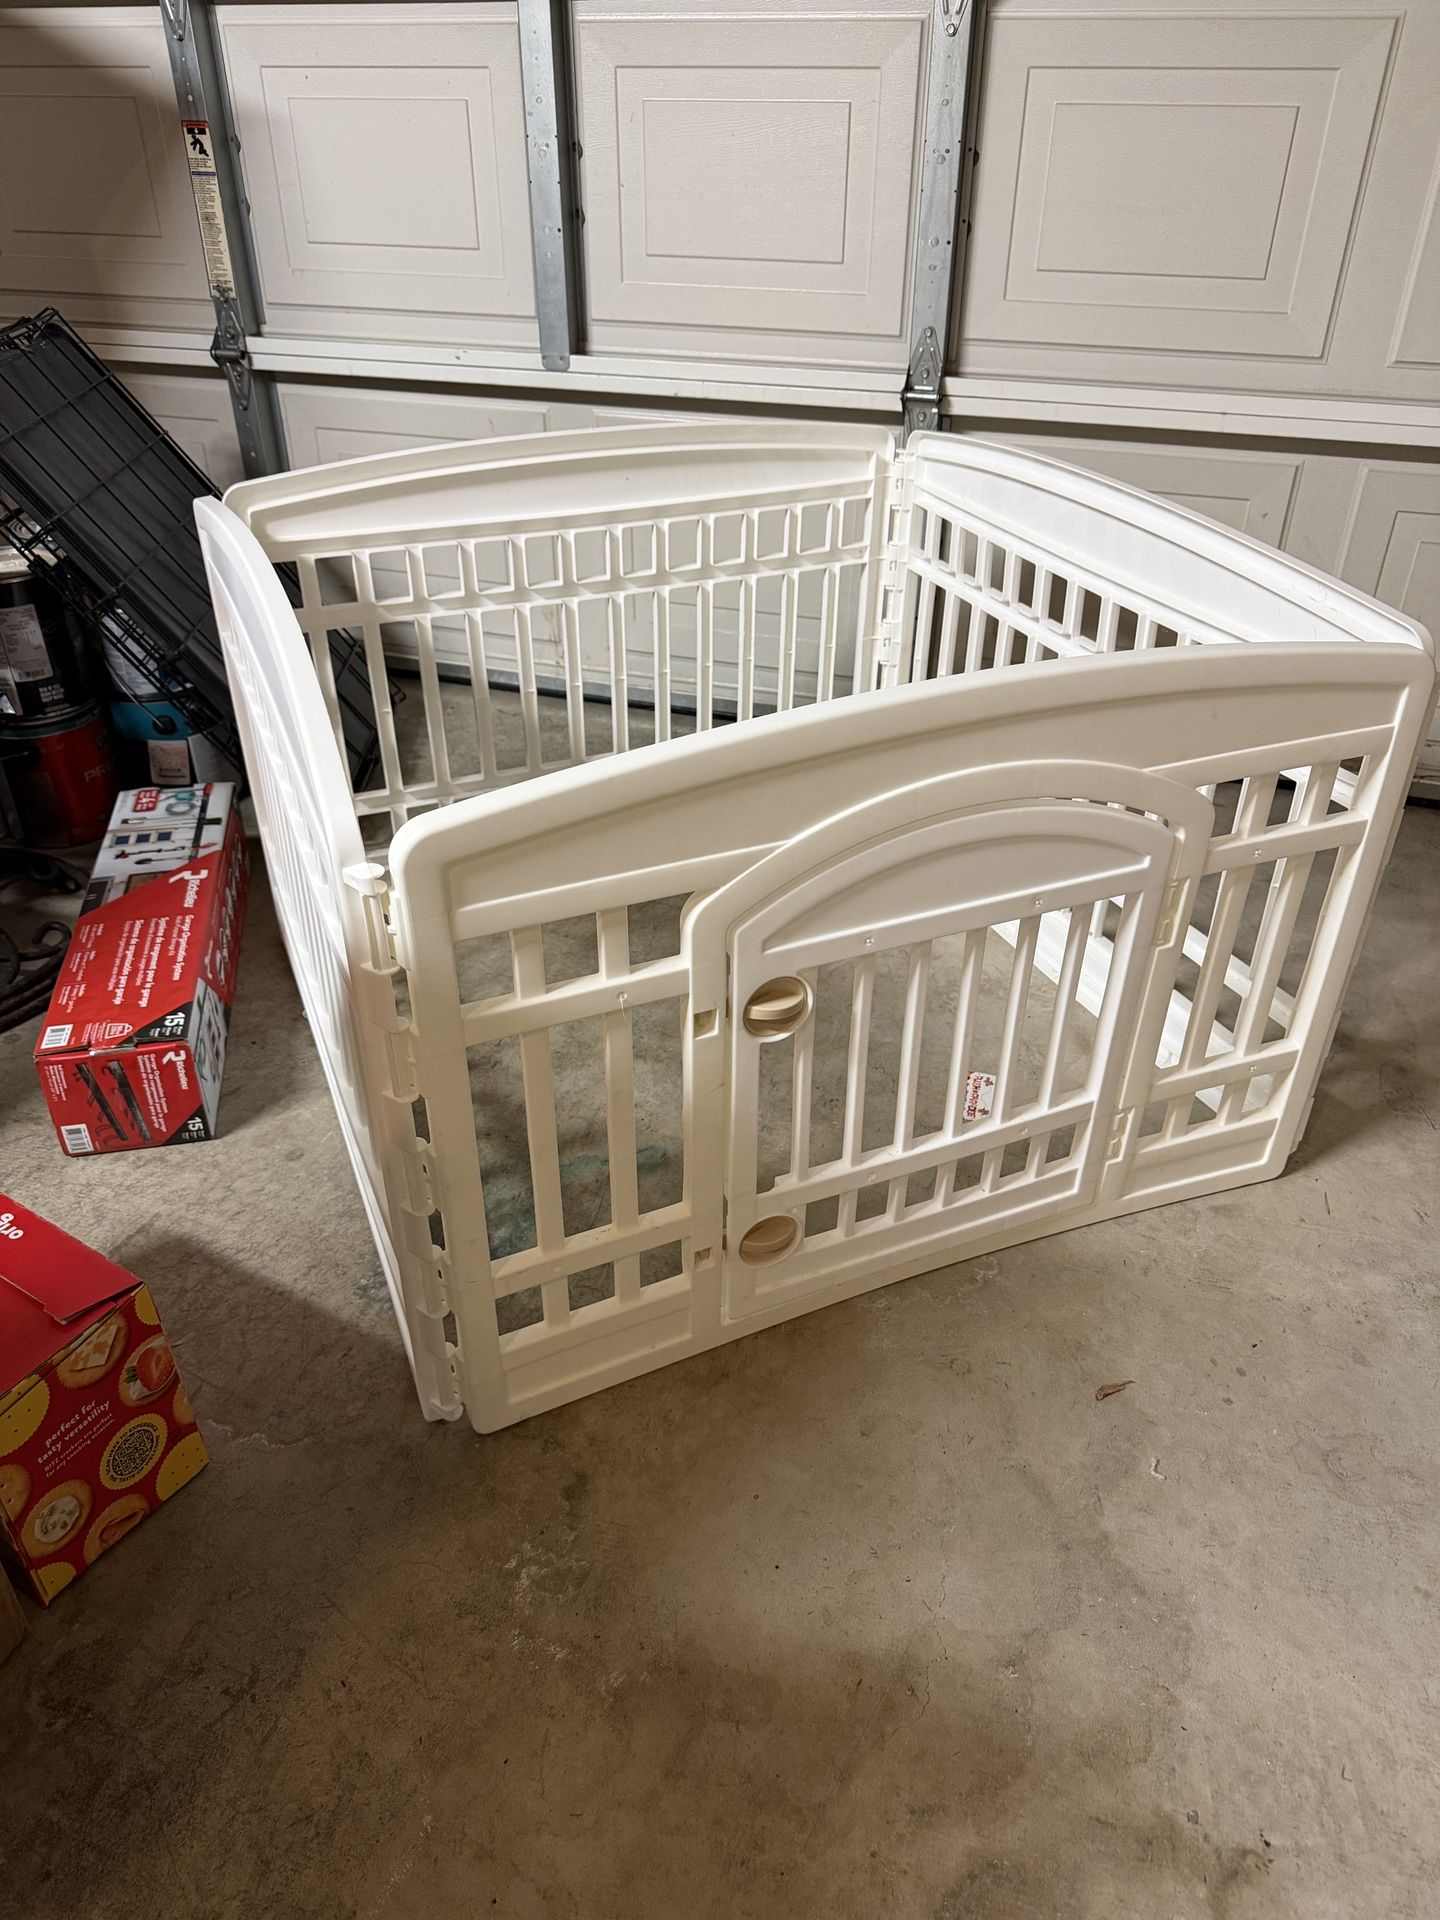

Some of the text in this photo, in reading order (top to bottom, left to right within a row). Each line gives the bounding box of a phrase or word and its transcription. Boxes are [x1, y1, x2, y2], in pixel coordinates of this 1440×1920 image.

[183, 879, 200, 907] Richelieu
[181, 914, 194, 931] Garage
[172, 962, 184, 980] System
[164, 1012, 185, 1026] 15
[176, 1061, 188, 1089] Richelieu
[187, 1117, 203, 1130] 15
[37, 1401, 109, 1463] tasty versatility
[45, 1400, 95, 1448] perfect for
